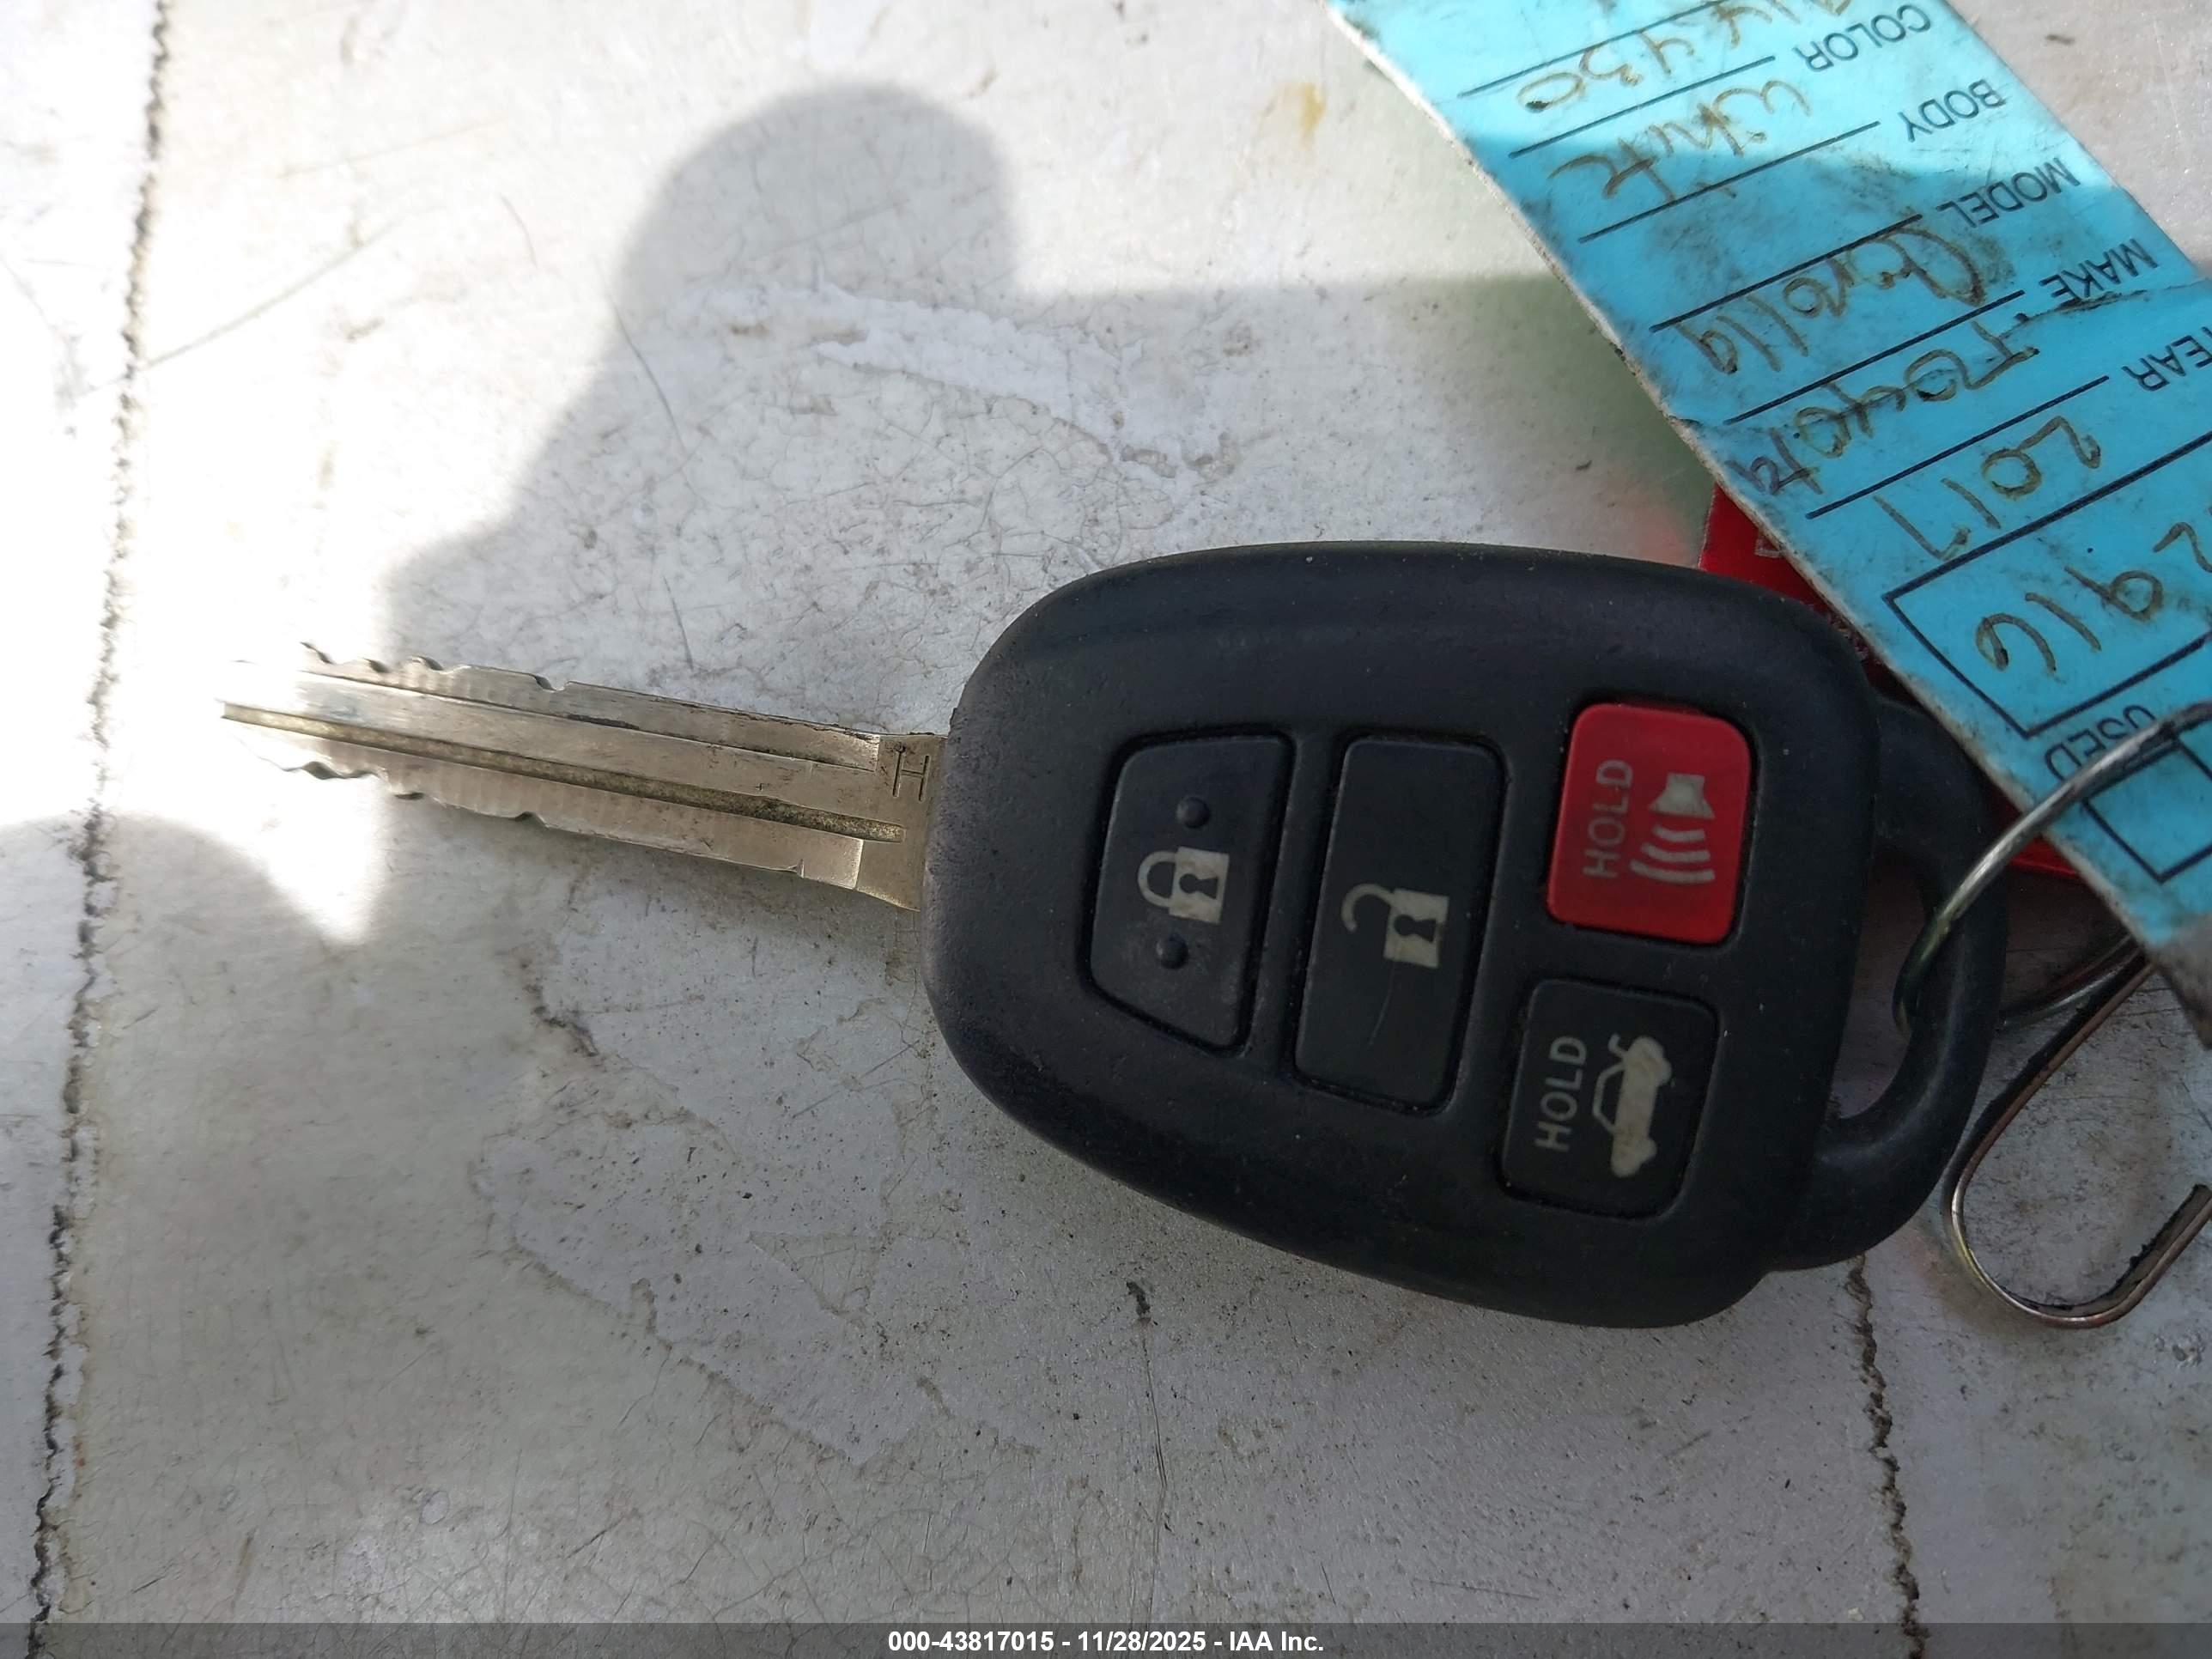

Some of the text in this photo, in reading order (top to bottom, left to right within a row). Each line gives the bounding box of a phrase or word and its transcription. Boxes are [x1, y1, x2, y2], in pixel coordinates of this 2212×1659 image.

[1794, 4, 1931, 72] COLOR
[1898, 78, 2008, 142] BODY
[1936, 157, 2081, 228] MODEL
[2039, 238, 2160, 305] MAKE
[2121, 327, 2212, 392] EAR
[1873, 416, 2102, 561] 2017
[1581, 759, 1633, 879] HOLD
[1534, 1036, 1588, 1152] HOLD
